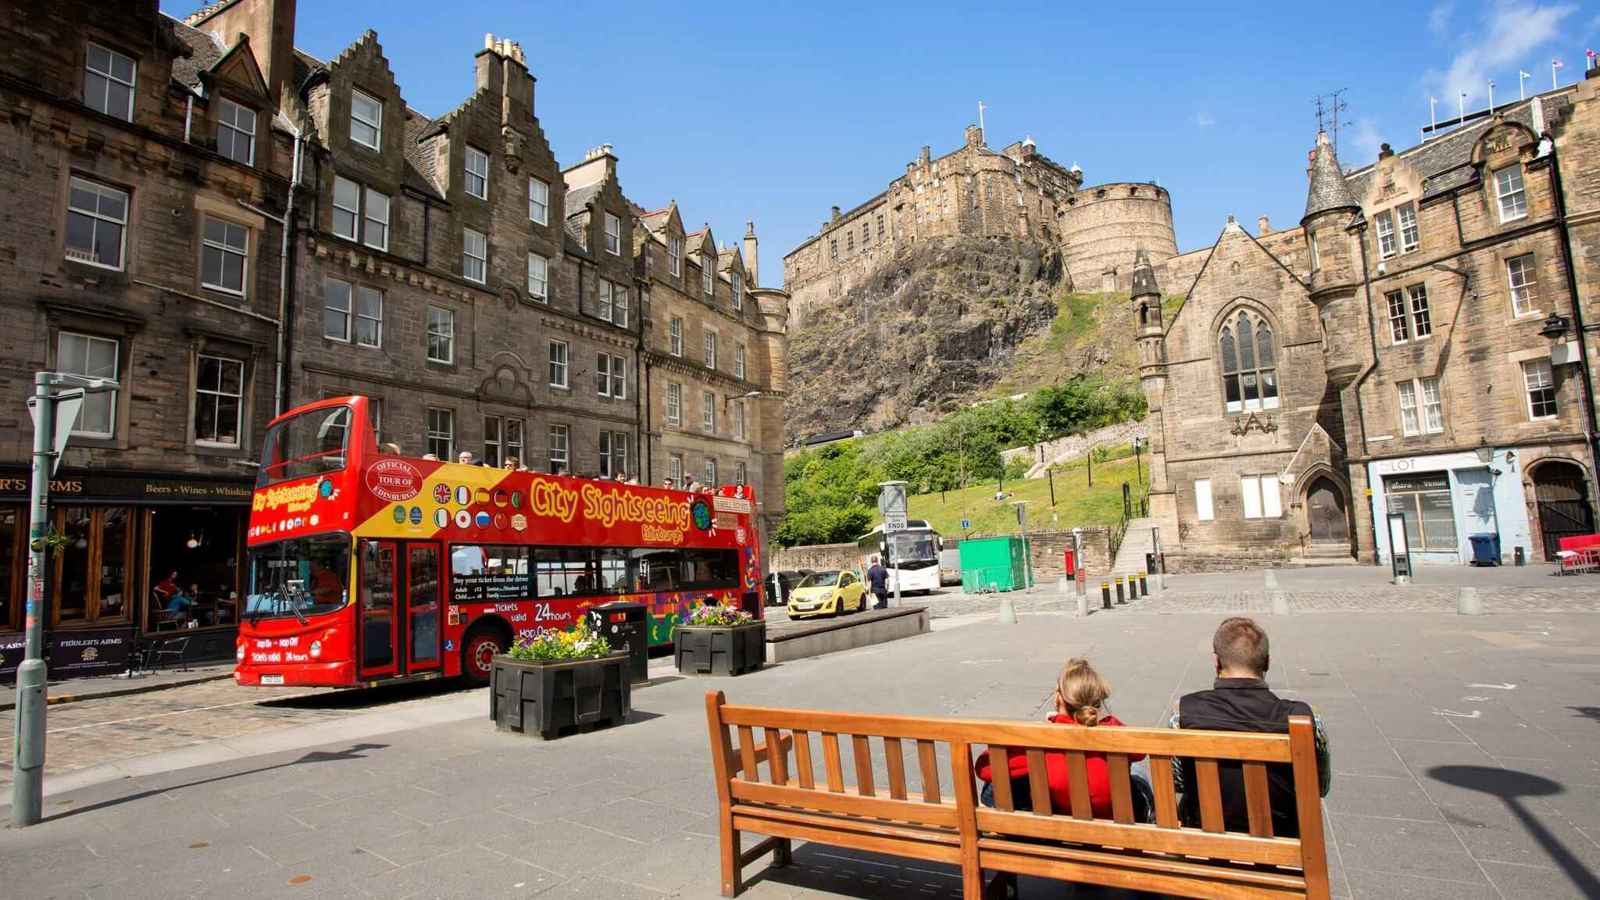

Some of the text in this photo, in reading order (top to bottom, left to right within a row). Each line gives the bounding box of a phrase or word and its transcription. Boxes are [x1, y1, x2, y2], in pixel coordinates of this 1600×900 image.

[377, 461, 411, 473] OFFICIAL
[1392, 459, 1415, 471] LOT
[48, 480, 82, 492] RMS
[379, 476, 413, 486] TOUR OF
[146, 485, 171, 493] Beers
[180, 485, 207, 494] Wines
[373, 486, 417, 500] EDINBURGH
[531, 478, 691, 531] City Sightseeing
[535, 603, 551, 621] 24
[550, 611, 571, 620] hours
